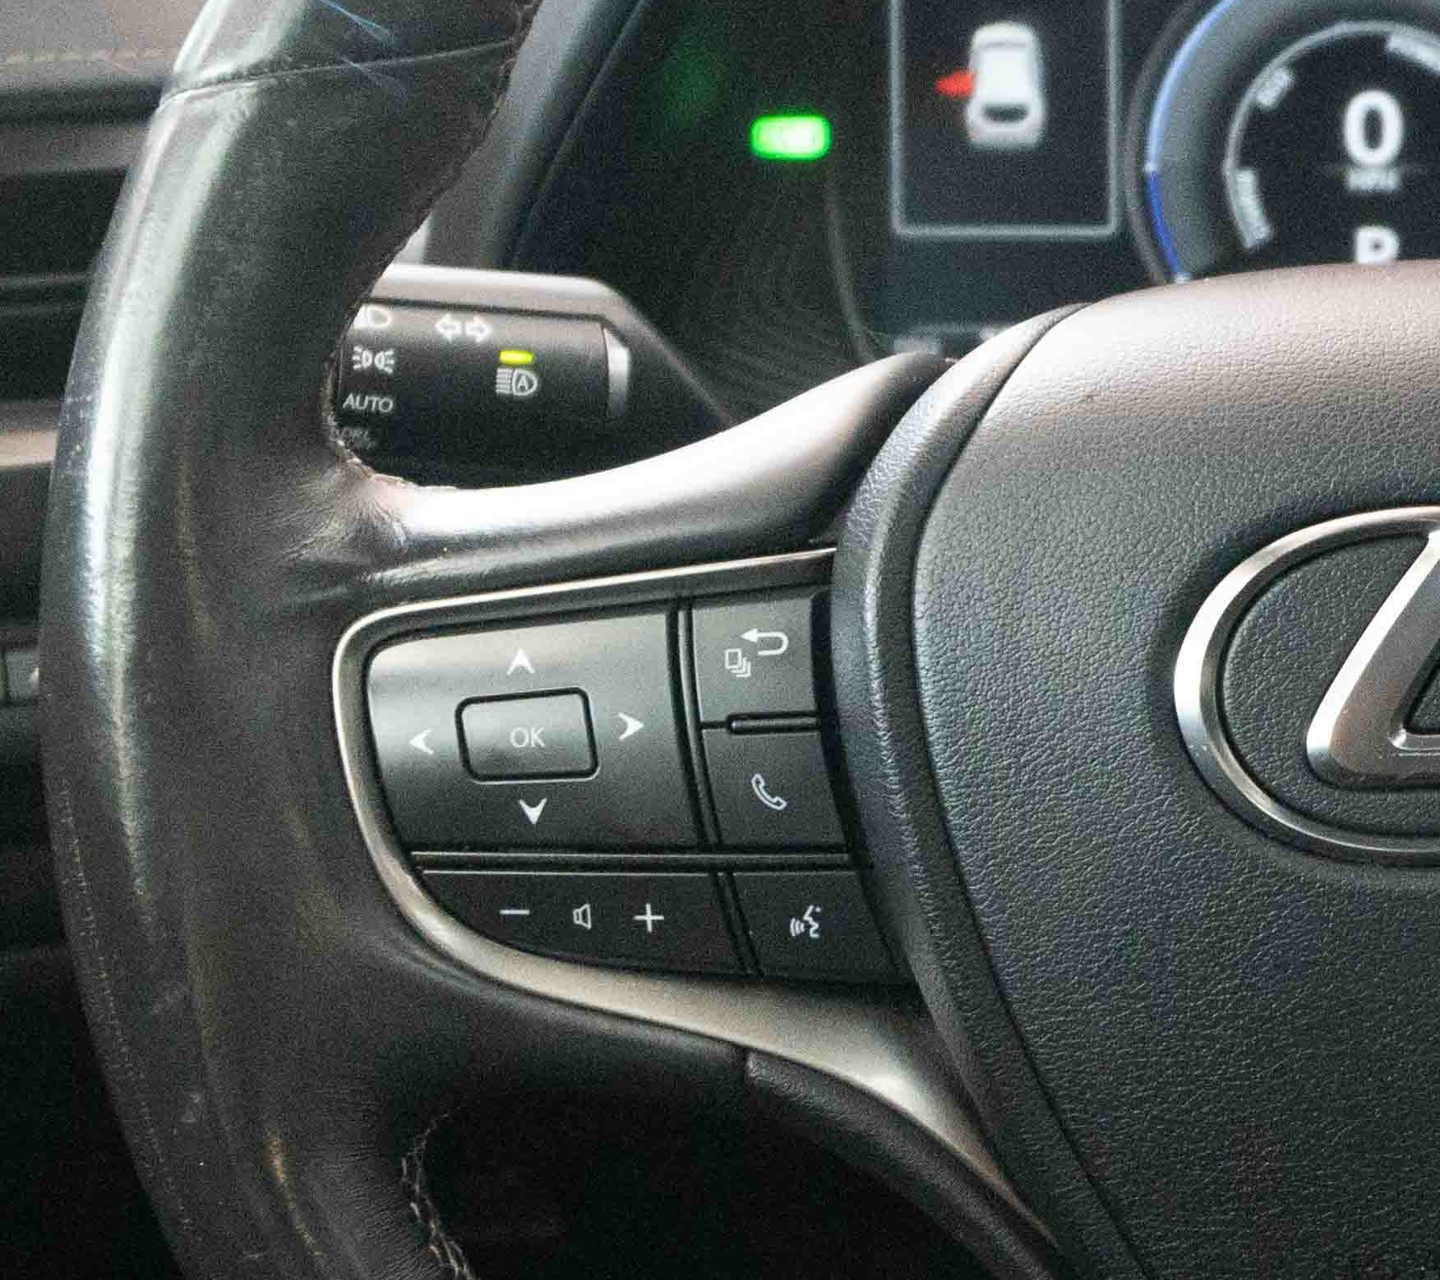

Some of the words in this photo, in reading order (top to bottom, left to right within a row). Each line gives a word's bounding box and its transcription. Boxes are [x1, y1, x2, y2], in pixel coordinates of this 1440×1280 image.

[1343, 89, 1404, 167] 0
[343, 392, 394, 413] AUTO
[510, 727, 546, 748] OK
